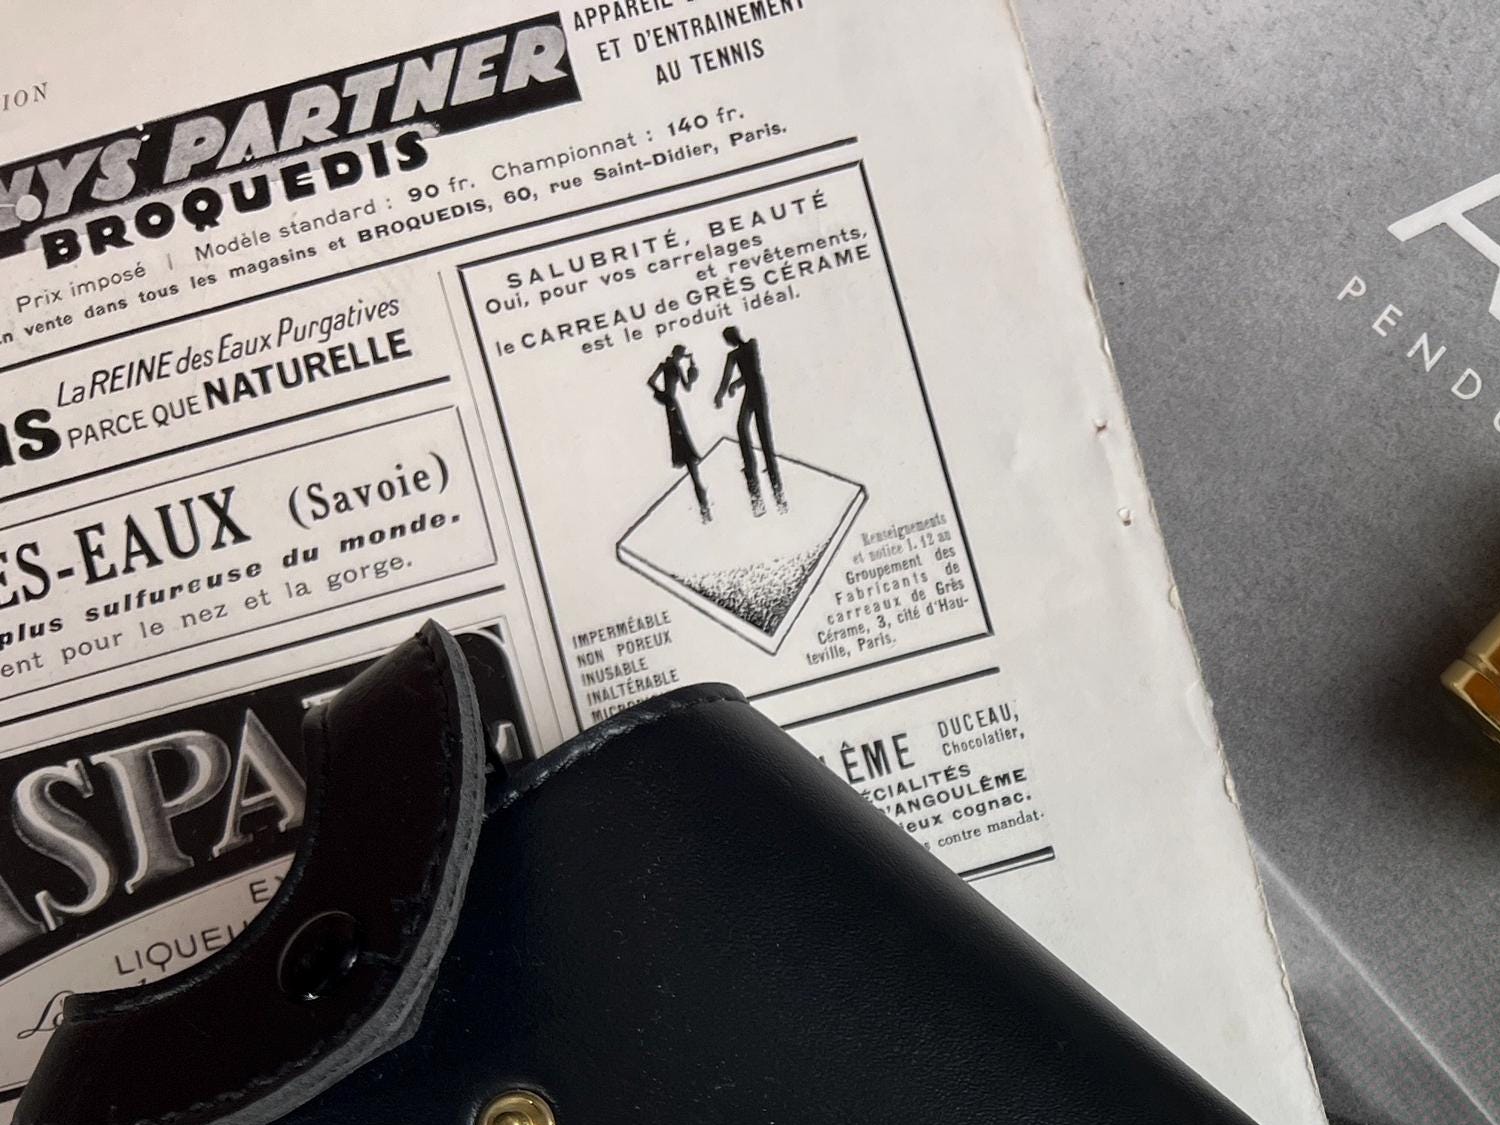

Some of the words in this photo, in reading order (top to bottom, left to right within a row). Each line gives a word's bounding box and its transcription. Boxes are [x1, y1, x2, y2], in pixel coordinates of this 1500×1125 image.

[596, 37, 621, 62] ET
[635, 0, 803, 53] D'ENTRAINEMENT
[655, 59, 682, 86] AU
[689, 38, 765, 75] TENNIS
[163, 26, 568, 185] PARTNER
[15, 289, 63, 313] Prix
[69, 261, 146, 297] imposé
[194, 230, 271, 262] Modèle
[278, 198, 376, 238] standard
[407, 184, 440, 203] 90
[447, 176, 475, 193] fr.
[491, 132, 637, 181] Championnat
[667, 114, 709, 137] 140
[716, 106, 744, 124] fr.
[23, 314, 73, 336] vente
[84, 298, 128, 319] dans
[138, 284, 180, 303] tous
[189, 274, 218, 289] les
[228, 246, 317, 279] magasins
[328, 236, 347, 251] et
[357, 198, 493, 243] BROQUEDIS,
[503, 186, 538, 204] 60,
[549, 176, 583, 194] rue
[593, 142, 719, 182] Saint-Didier,
[729, 123, 787, 147] Paris.
[41, 131, 429, 268] BROQUEDIS
[506, 232, 690, 289] SALUBRITÉ,
[708, 188, 828, 238] BEAUTÉ
[696, 263, 717, 281] et
[728, 228, 867, 274] revêtements,
[485, 292, 529, 315] Oui,
[539, 280, 588, 306] pour
[599, 268, 636, 286] vos
[647, 235, 763, 274] carrelages
[495, 341, 515, 357] le
[520, 302, 646, 349] CARREAU
[655, 297, 680, 315] de
[686, 275, 756, 306] GRÈS
[763, 244, 871, 286] CÉRAME
[57, 381, 86, 408] La
[89, 350, 173, 399] REINE
[175, 345, 214, 375] des
[217, 332, 272, 364] Eaux
[277, 298, 400, 348] Purgatives
[581, 333, 614, 354] est
[623, 327, 643, 343] le
[655, 303, 732, 338] produit
[742, 284, 800, 312] idéal.
[67, 409, 148, 449] PARCE
[151, 395, 202, 428] QUE
[202, 328, 413, 410] NATURELLE
[288, 452, 449, 530] (Savoie)
[85, 562, 262, 622] sulfureuse
[282, 547, 319, 568] du
[340, 513, 460, 553] monde.
[572, 611, 671, 649] IMPERMÉABLE
[805, 644, 851, 666] teville,
[857, 632, 896, 652] Paris.
[817, 623, 871, 645] Cérame,
[876, 614, 892, 629] 3,
[896, 605, 921, 624] cité
[581, 657, 649, 686] INUSABLE
[587, 669, 680, 706] INALTÉRABLE
[937, 703, 1019, 739] DUCEAU,
[941, 727, 1025, 757] Chocolatier,
[952, 792, 1032, 821] cognac.
